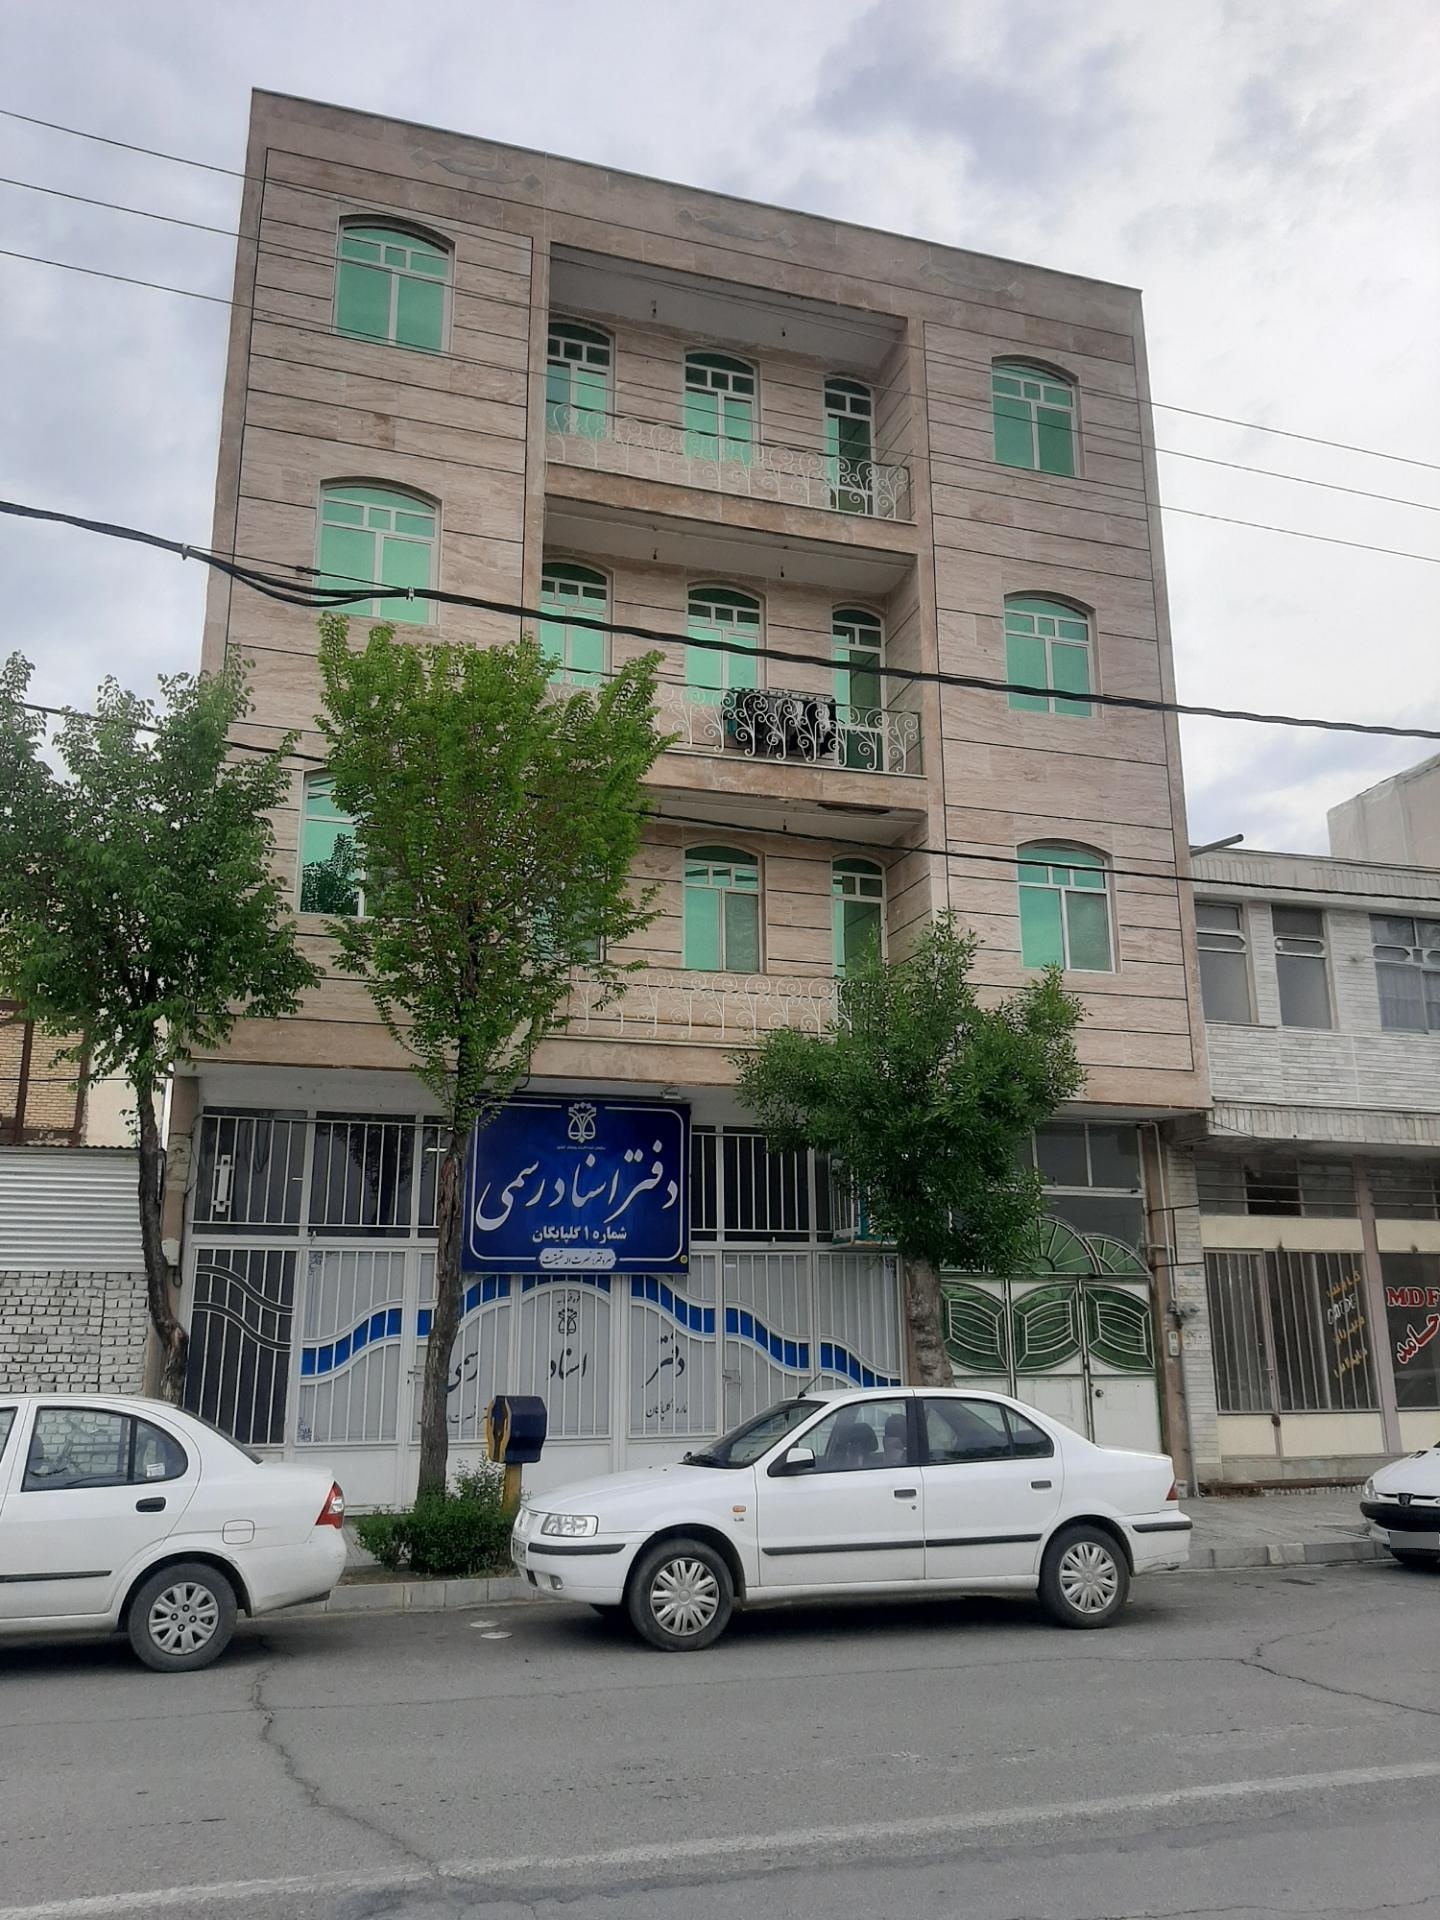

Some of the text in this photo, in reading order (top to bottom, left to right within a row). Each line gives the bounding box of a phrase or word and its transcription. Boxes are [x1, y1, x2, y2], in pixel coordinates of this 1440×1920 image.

[475, 1139, 679, 1231] دفتر اسناد رسمی
[531, 1224, 581, 1244] گلپایگان
[592, 1225, 628, 1244] شماره
[1386, 1286, 1440, 1308] MDF
[546, 1347, 588, 1381] اسناد
